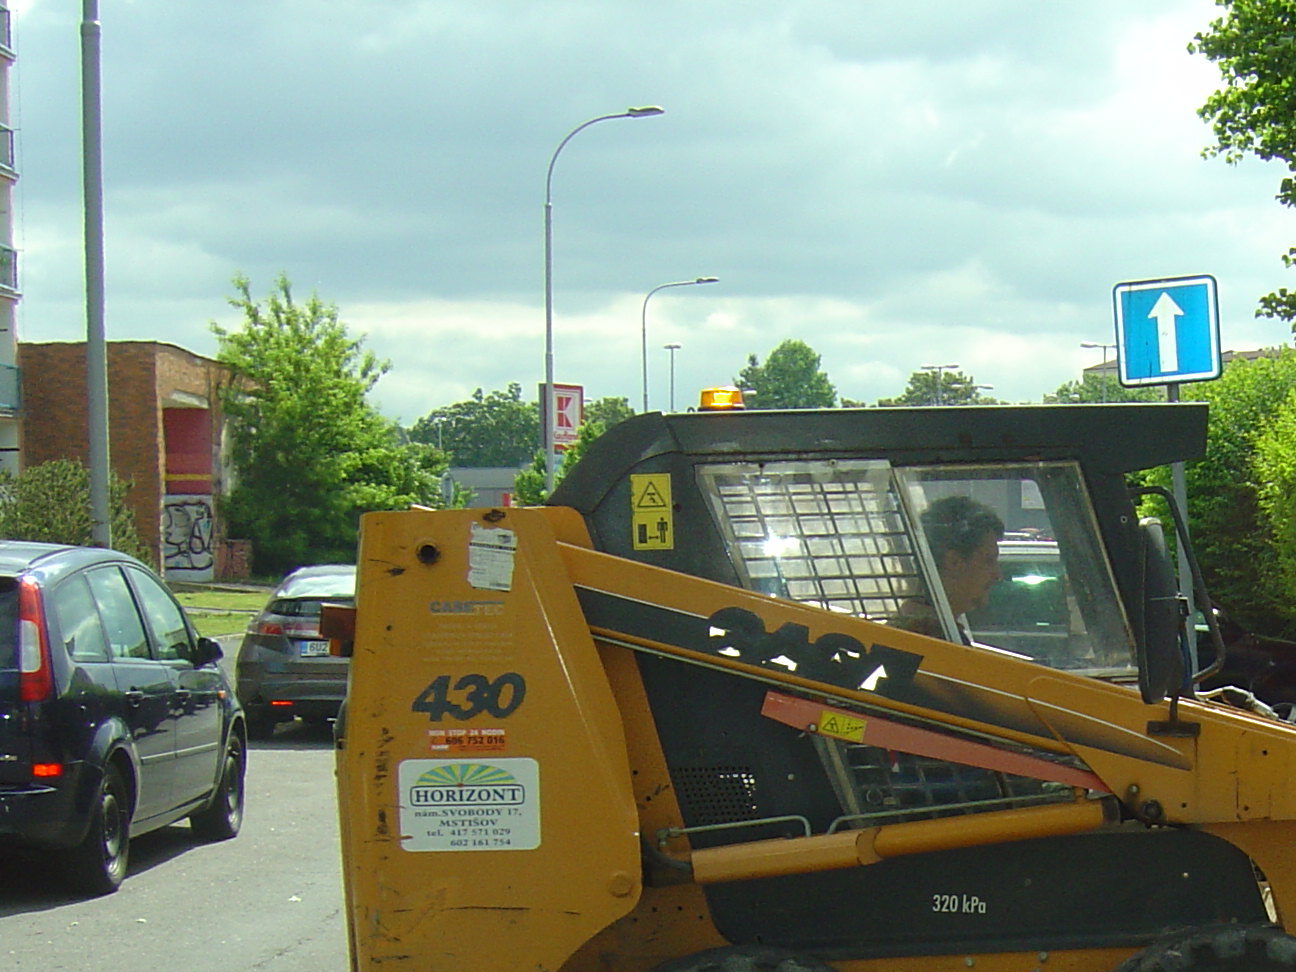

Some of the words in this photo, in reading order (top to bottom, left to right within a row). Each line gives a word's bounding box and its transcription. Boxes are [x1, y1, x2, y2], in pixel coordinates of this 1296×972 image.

[557, 396, 572, 427] K
[411, 672, 526, 722] 430
[415, 788, 521, 803] HORIZONT
[439, 817, 498, 828] MSTIŠOV
[932, 894, 959, 912] 320
[962, 894, 987, 913] kPa
